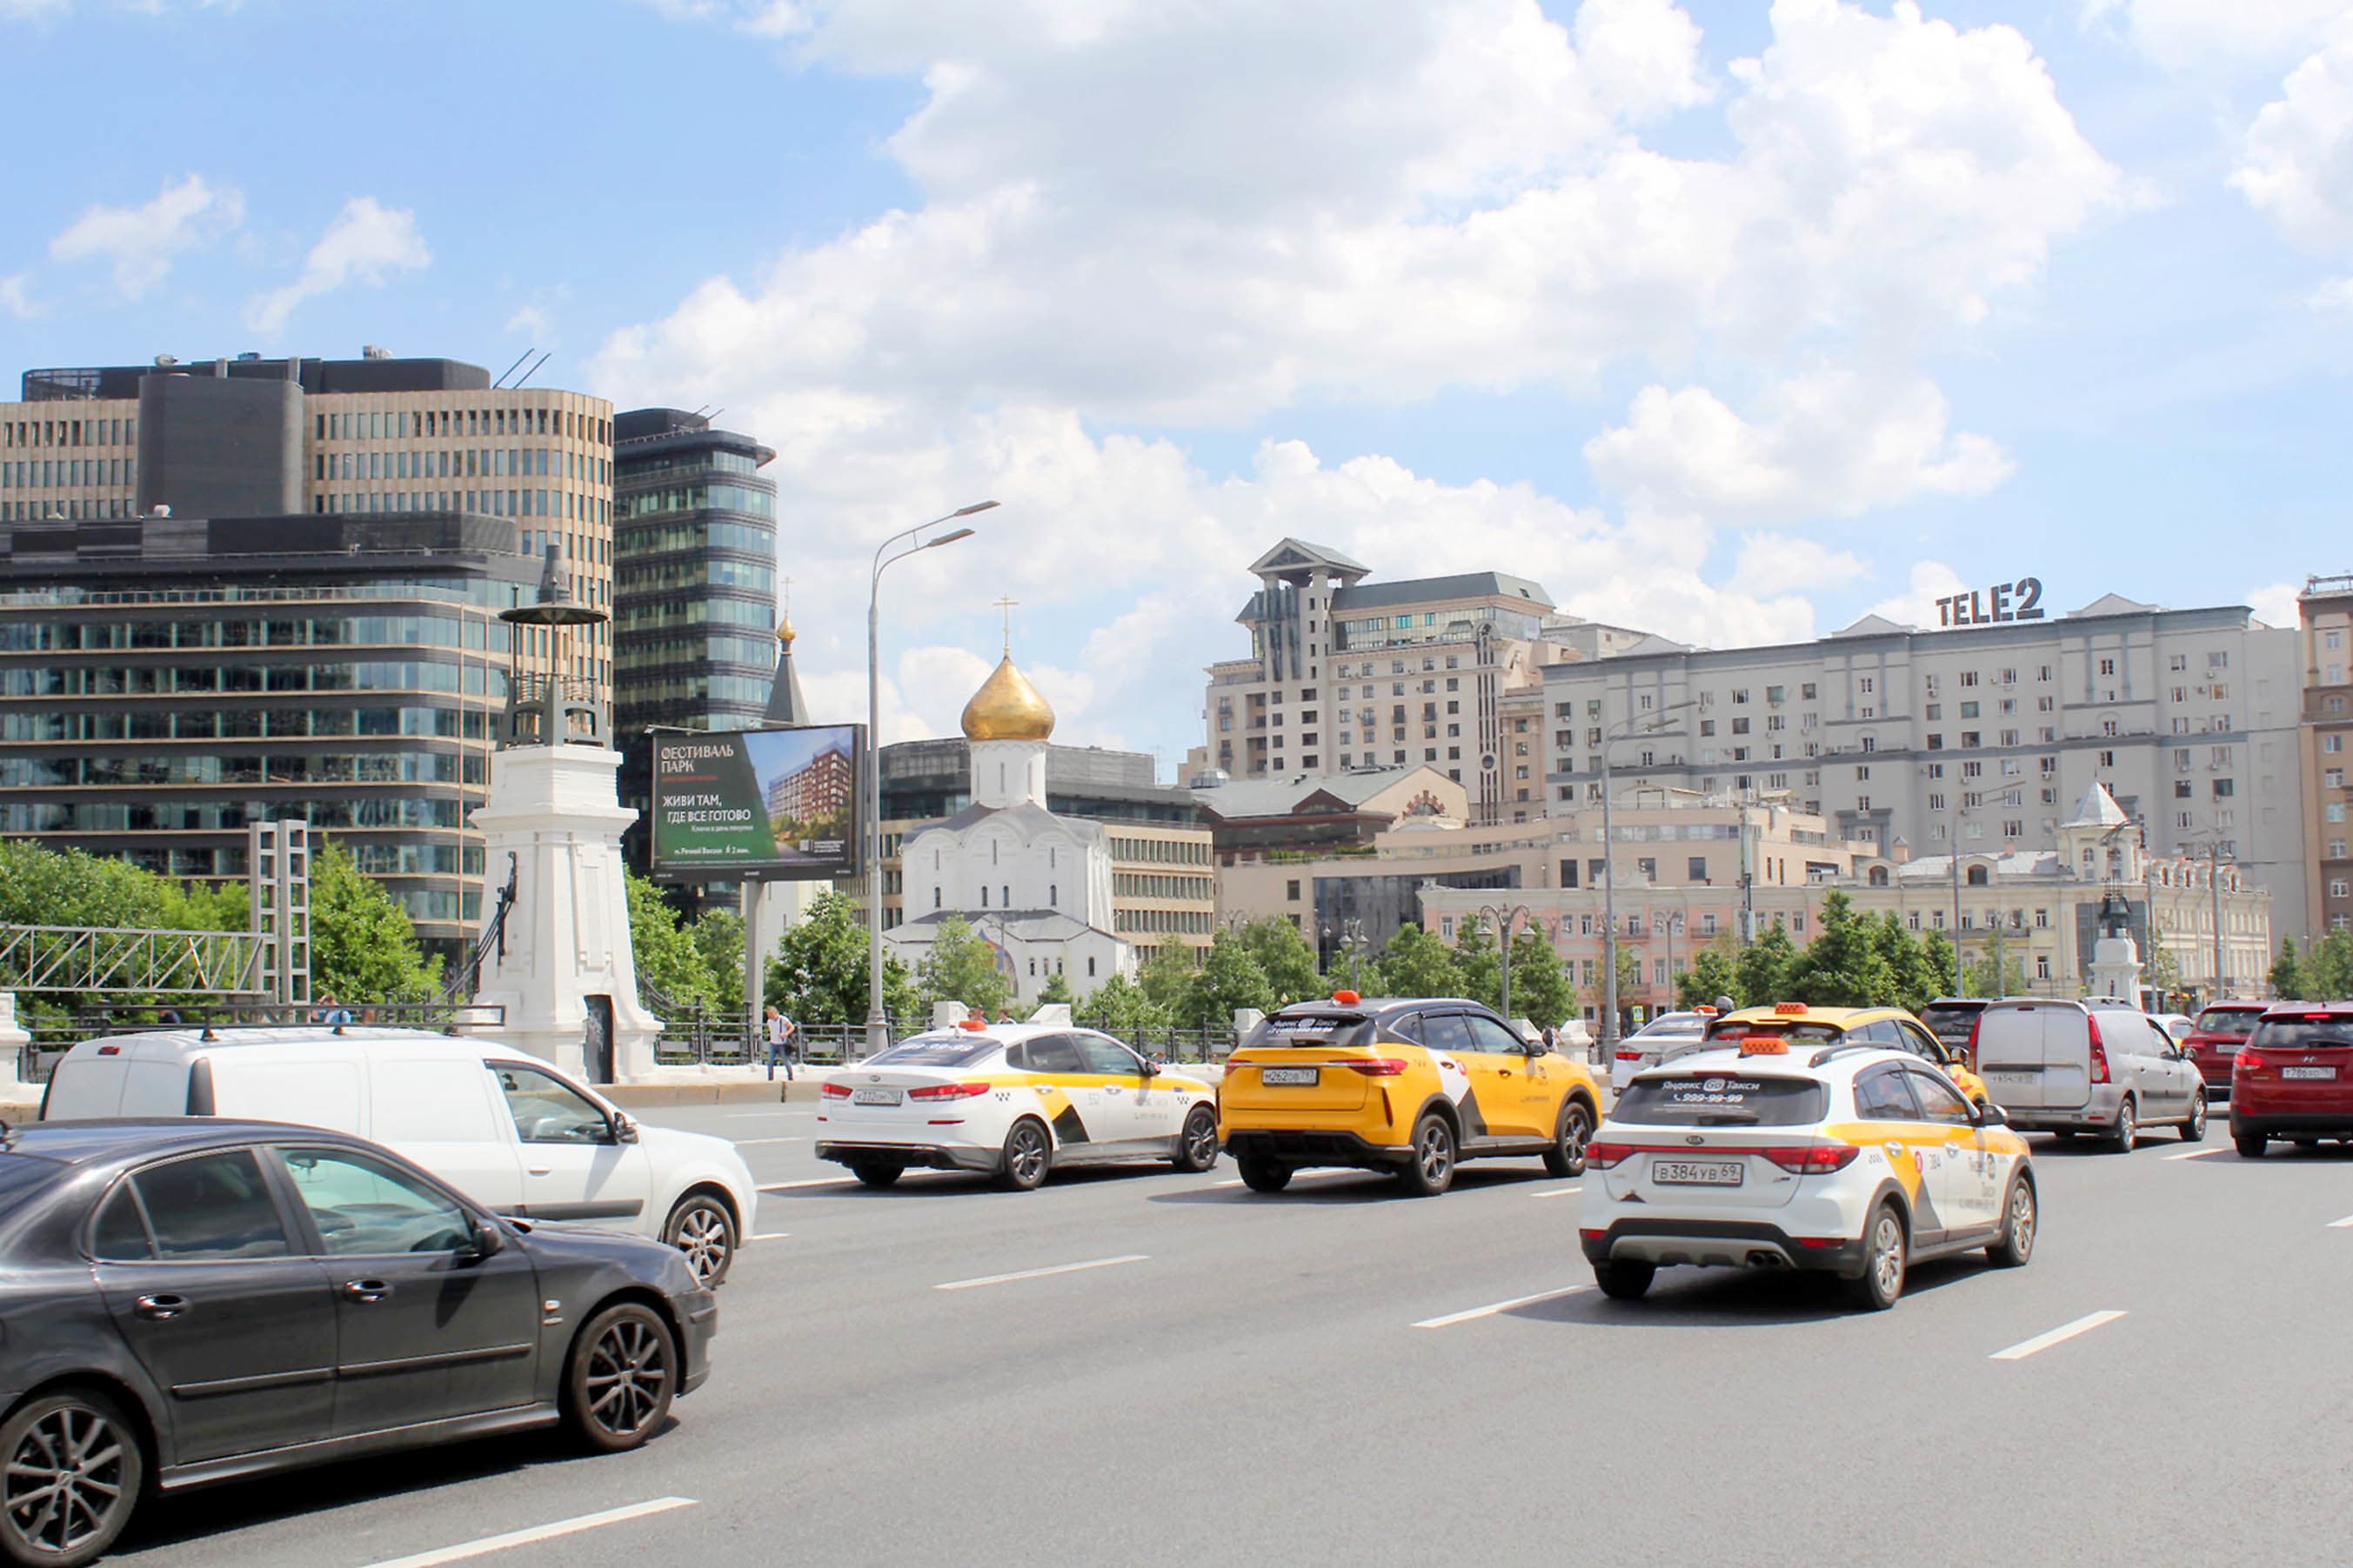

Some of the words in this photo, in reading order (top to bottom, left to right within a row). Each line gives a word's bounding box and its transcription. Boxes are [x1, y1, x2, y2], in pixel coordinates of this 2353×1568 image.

[1935, 577, 2044, 626] TELE2
[661, 744, 733, 760] ФЕСТИВАЛЬ
[661, 760, 694, 773] ПАРК
[663, 795, 695, 807] ЖИВИ
[697, 794, 722, 807] ТАМ,
[667, 811, 685, 824] ГДЕ
[687, 810, 706, 822] ВСЕ
[708, 809, 751, 821] ГОТОВО
[1662, 1081, 1702, 1091] Яндекс
[1727, 1080, 1760, 1090] Такси
